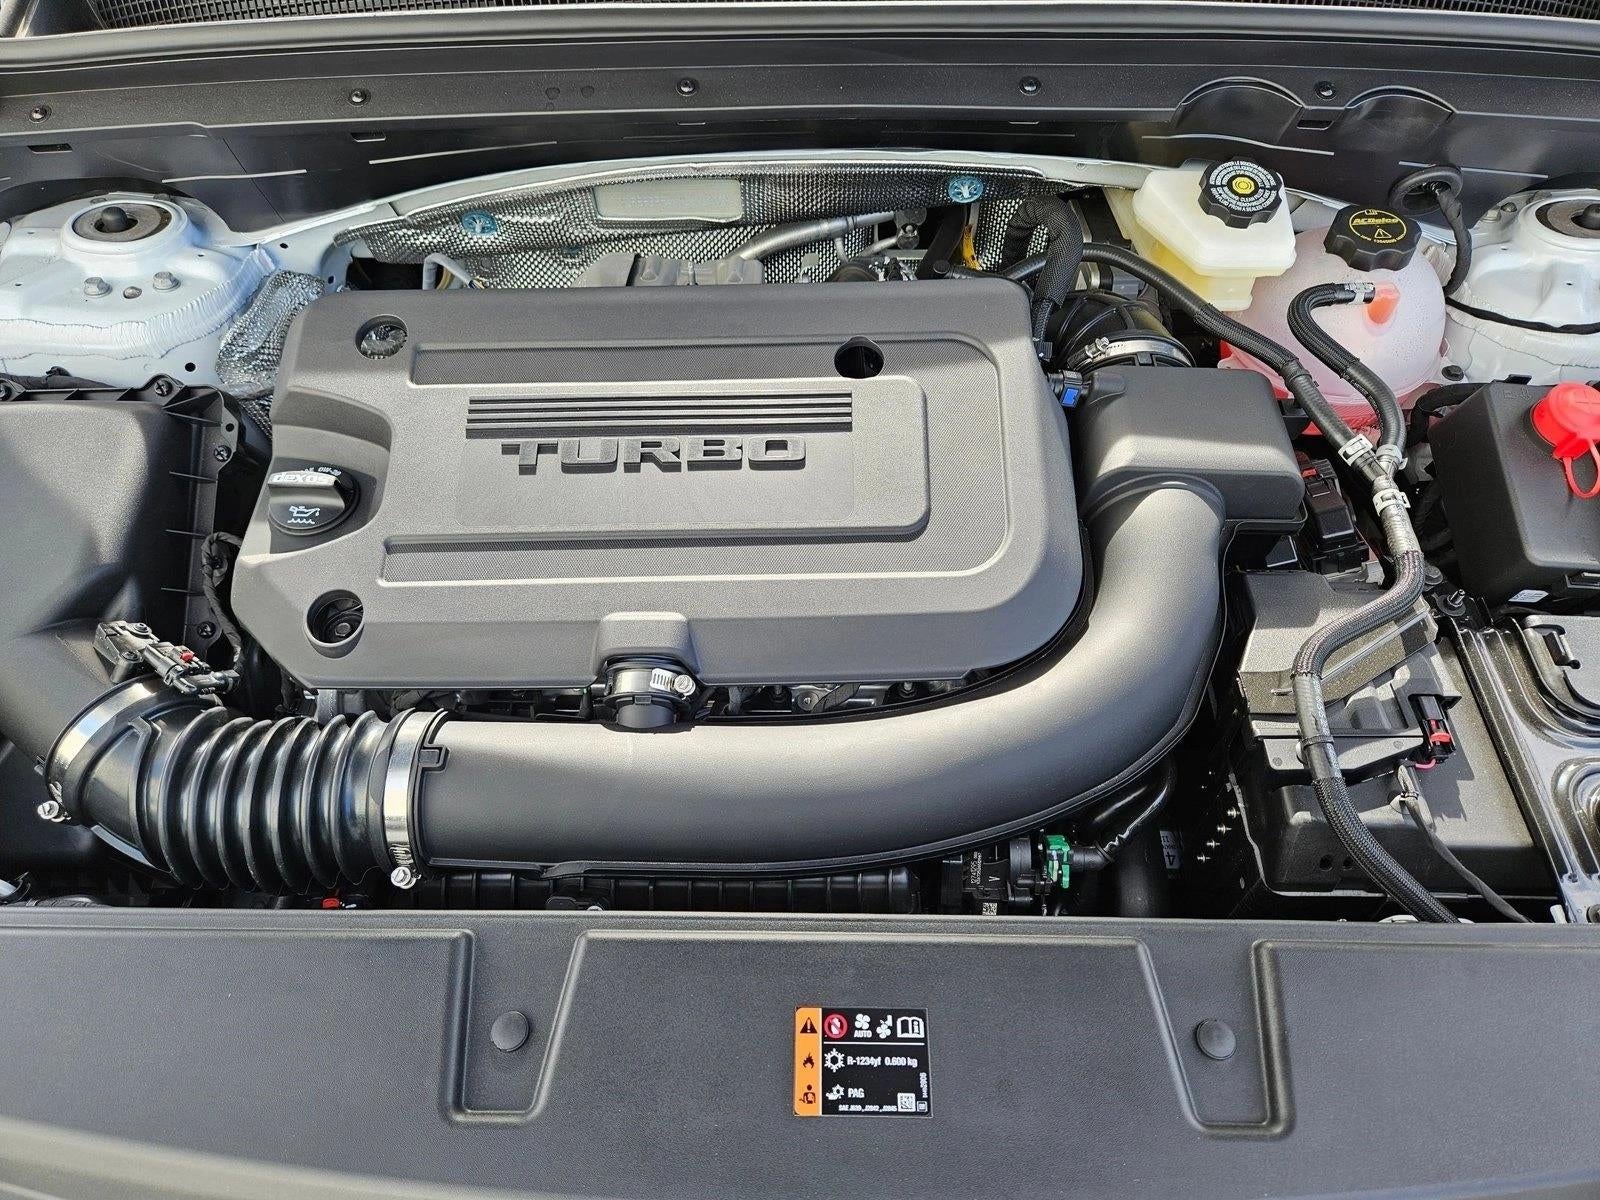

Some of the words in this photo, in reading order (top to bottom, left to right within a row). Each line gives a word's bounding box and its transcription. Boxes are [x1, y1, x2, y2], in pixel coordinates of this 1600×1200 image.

[1352, 217, 1399, 225] ACDelco
[501, 437, 806, 475] TURBO
[854, 1030, 872, 1038] AUTO
[847, 1056, 881, 1067] R-1234yf
[884, 1056, 906, 1066] 0.600
[907, 1057, 918, 1068] kg
[847, 1088, 865, 1099] PAG
